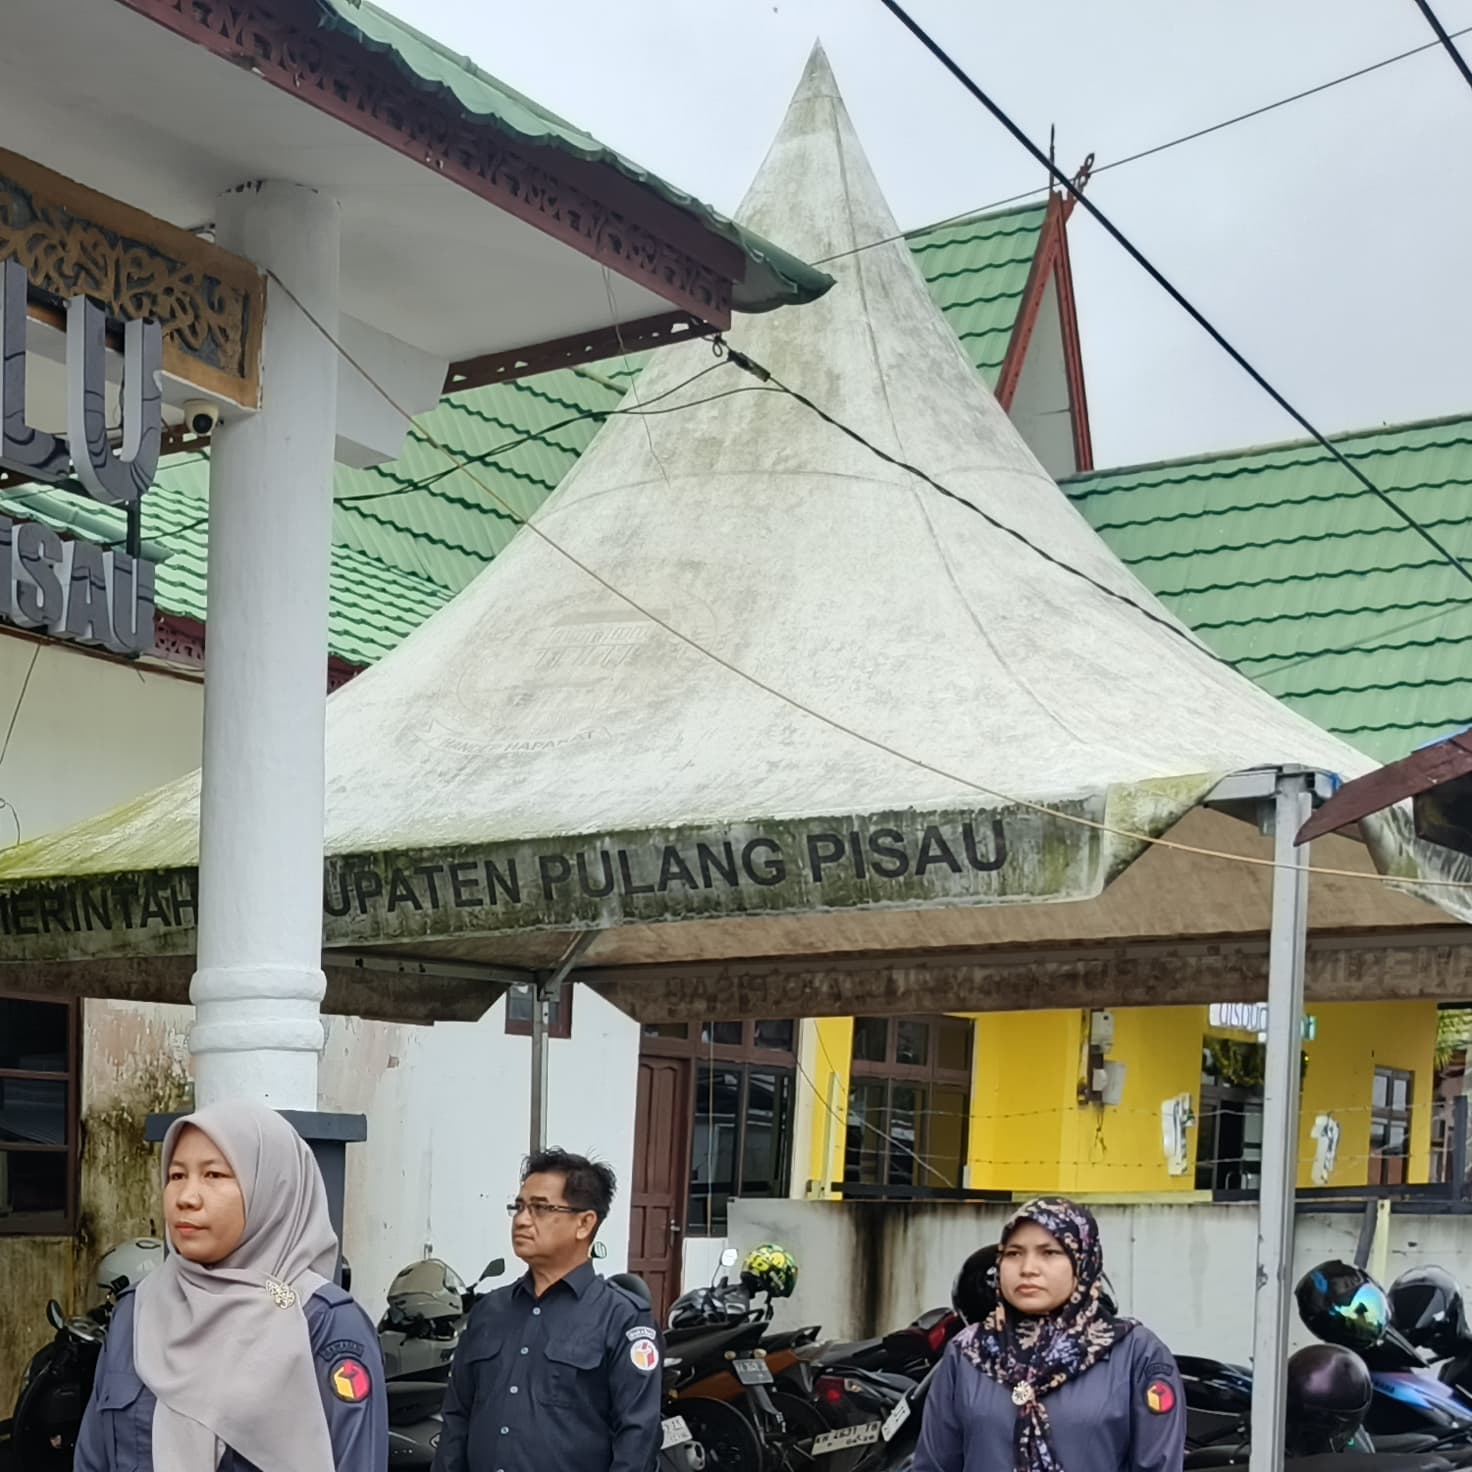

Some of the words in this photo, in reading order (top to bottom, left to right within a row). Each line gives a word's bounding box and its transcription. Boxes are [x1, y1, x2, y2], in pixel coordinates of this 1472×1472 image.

[323, 856, 523, 917] UPATEN
[538, 836, 787, 901] PULANG
[807, 818, 1009, 883] PISAU
